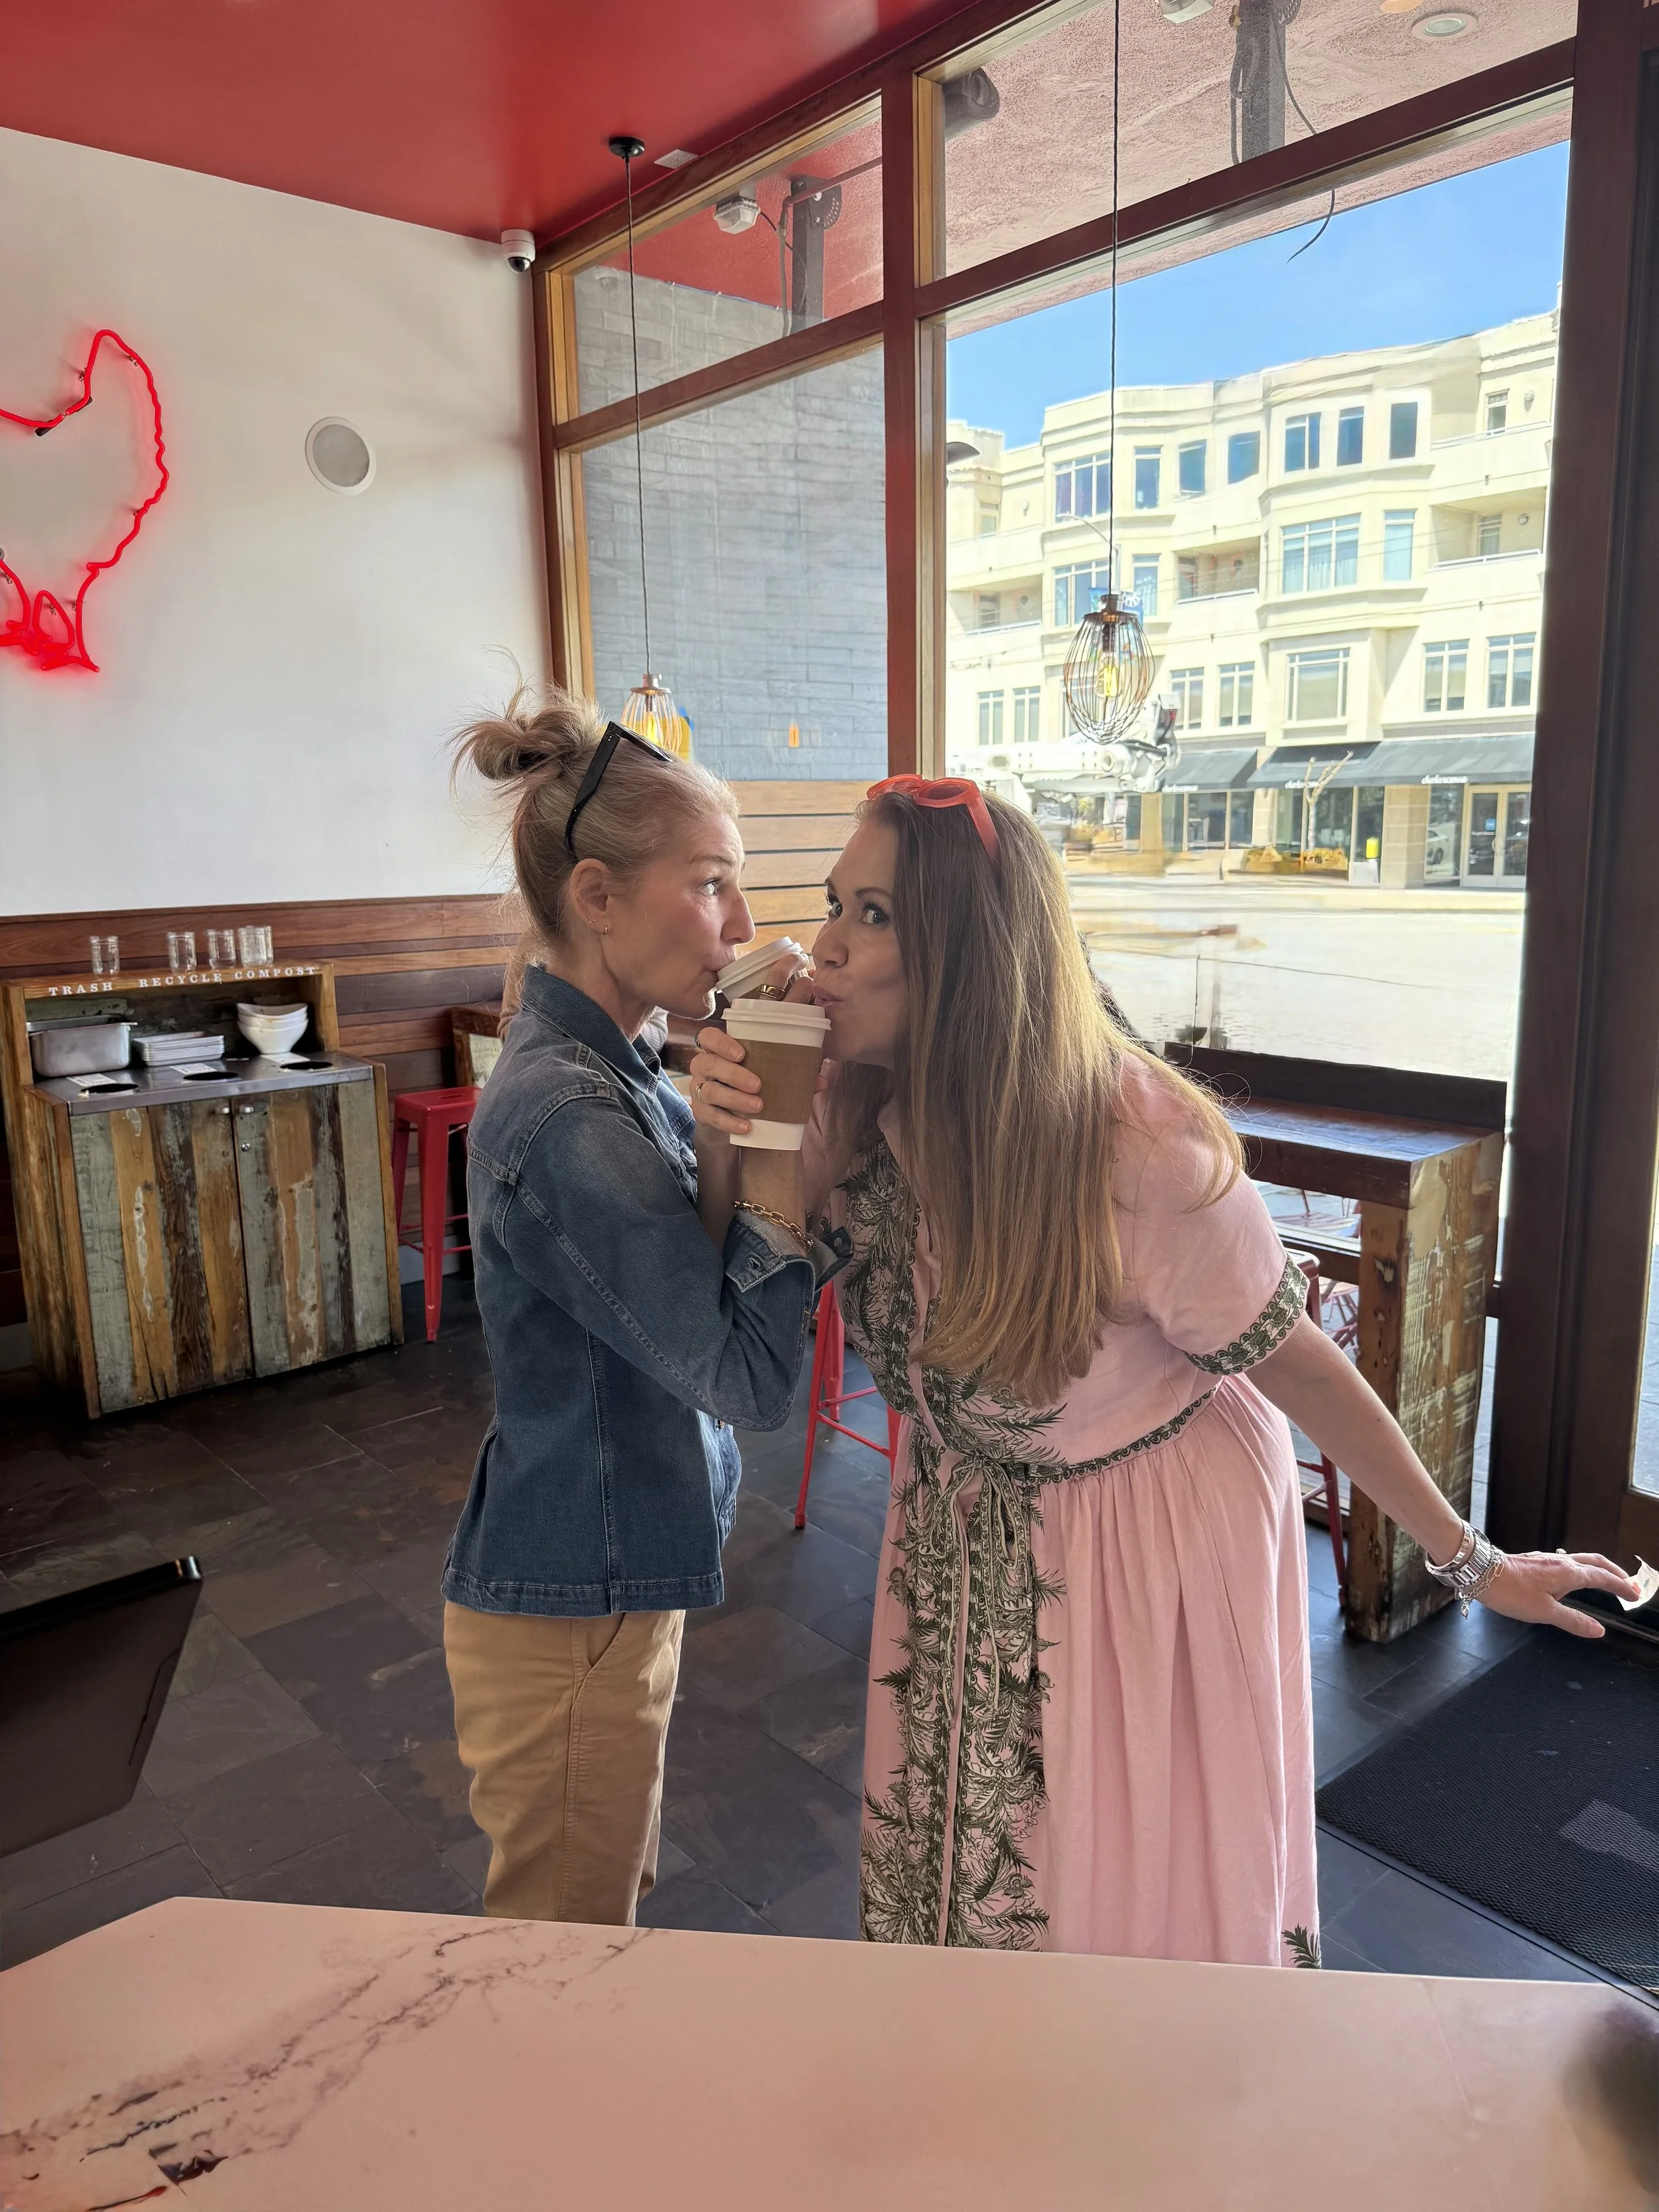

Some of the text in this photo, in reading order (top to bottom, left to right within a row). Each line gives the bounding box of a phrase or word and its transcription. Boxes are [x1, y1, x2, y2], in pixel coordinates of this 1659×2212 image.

[48, 966, 315, 996] TRASH RECYCLE COMPOST
